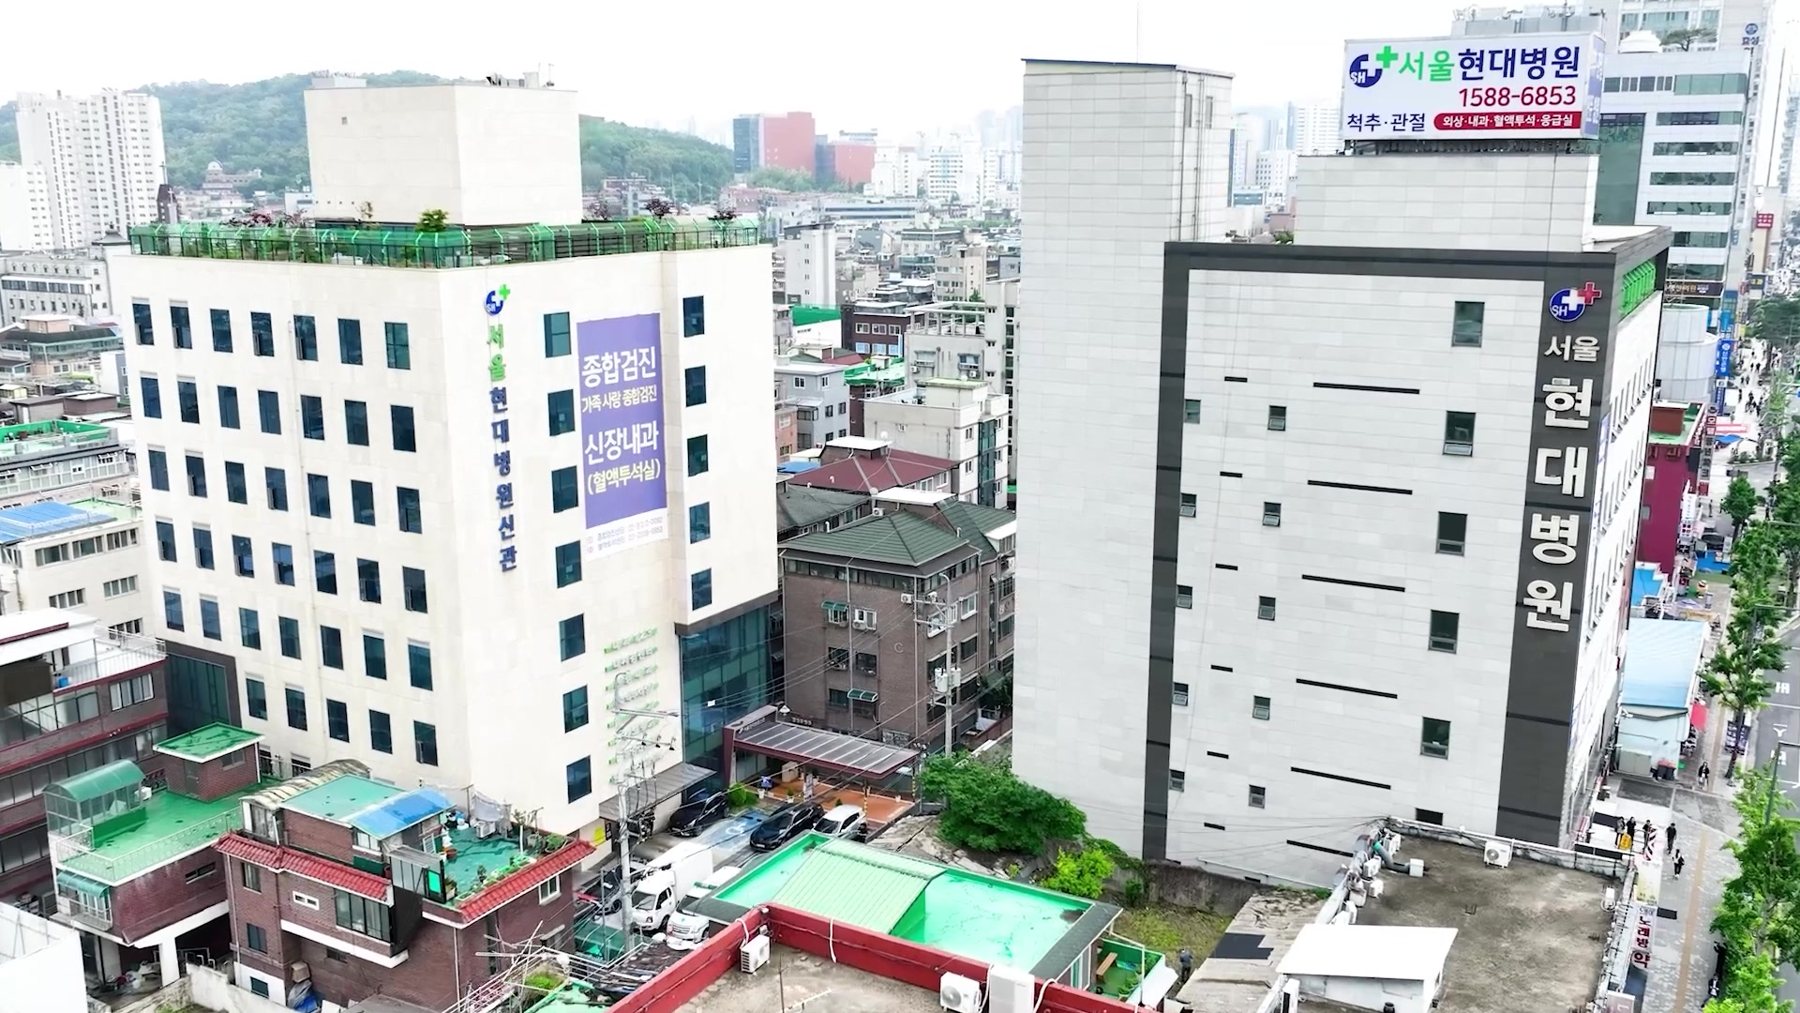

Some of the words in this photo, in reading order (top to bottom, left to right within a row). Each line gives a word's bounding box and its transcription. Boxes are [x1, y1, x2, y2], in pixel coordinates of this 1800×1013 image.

[1350, 71, 1366, 84] SH
[1458, 85, 1576, 107] 1588-6853
[1347, 113, 1425, 132] 척추·관절
[1551, 304, 1567, 317] SH
[1543, 335, 1601, 362] 서울
[582, 346, 656, 388] 종합검진
[585, 420, 659, 465] 신장내과
[588, 458, 661, 496] (혈액투석실)
